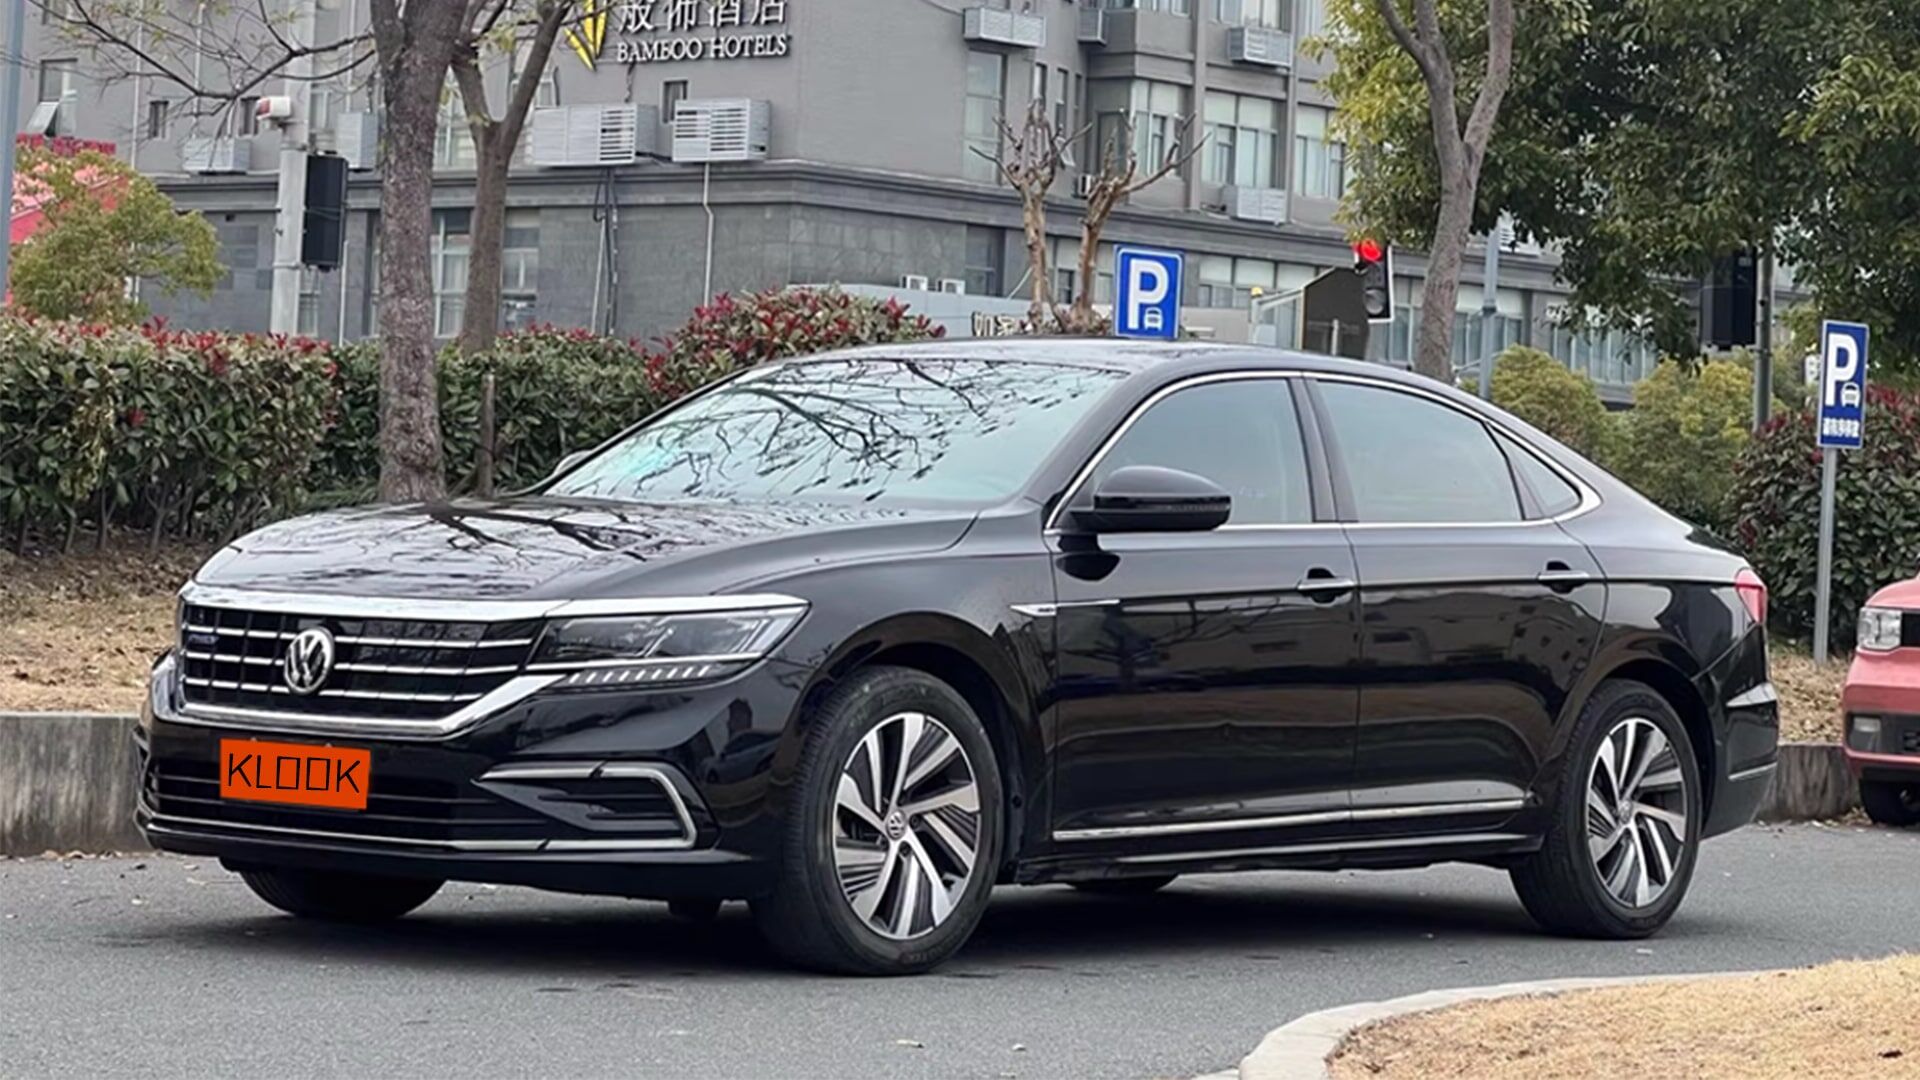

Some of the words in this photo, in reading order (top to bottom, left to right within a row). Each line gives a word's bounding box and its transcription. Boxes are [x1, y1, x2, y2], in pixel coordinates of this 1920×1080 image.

[617, 38, 703, 62] BAMBOO
[709, 34, 788, 57] HOTELS
[1128, 258, 1170, 330] P
[1825, 332, 1859, 406] P
